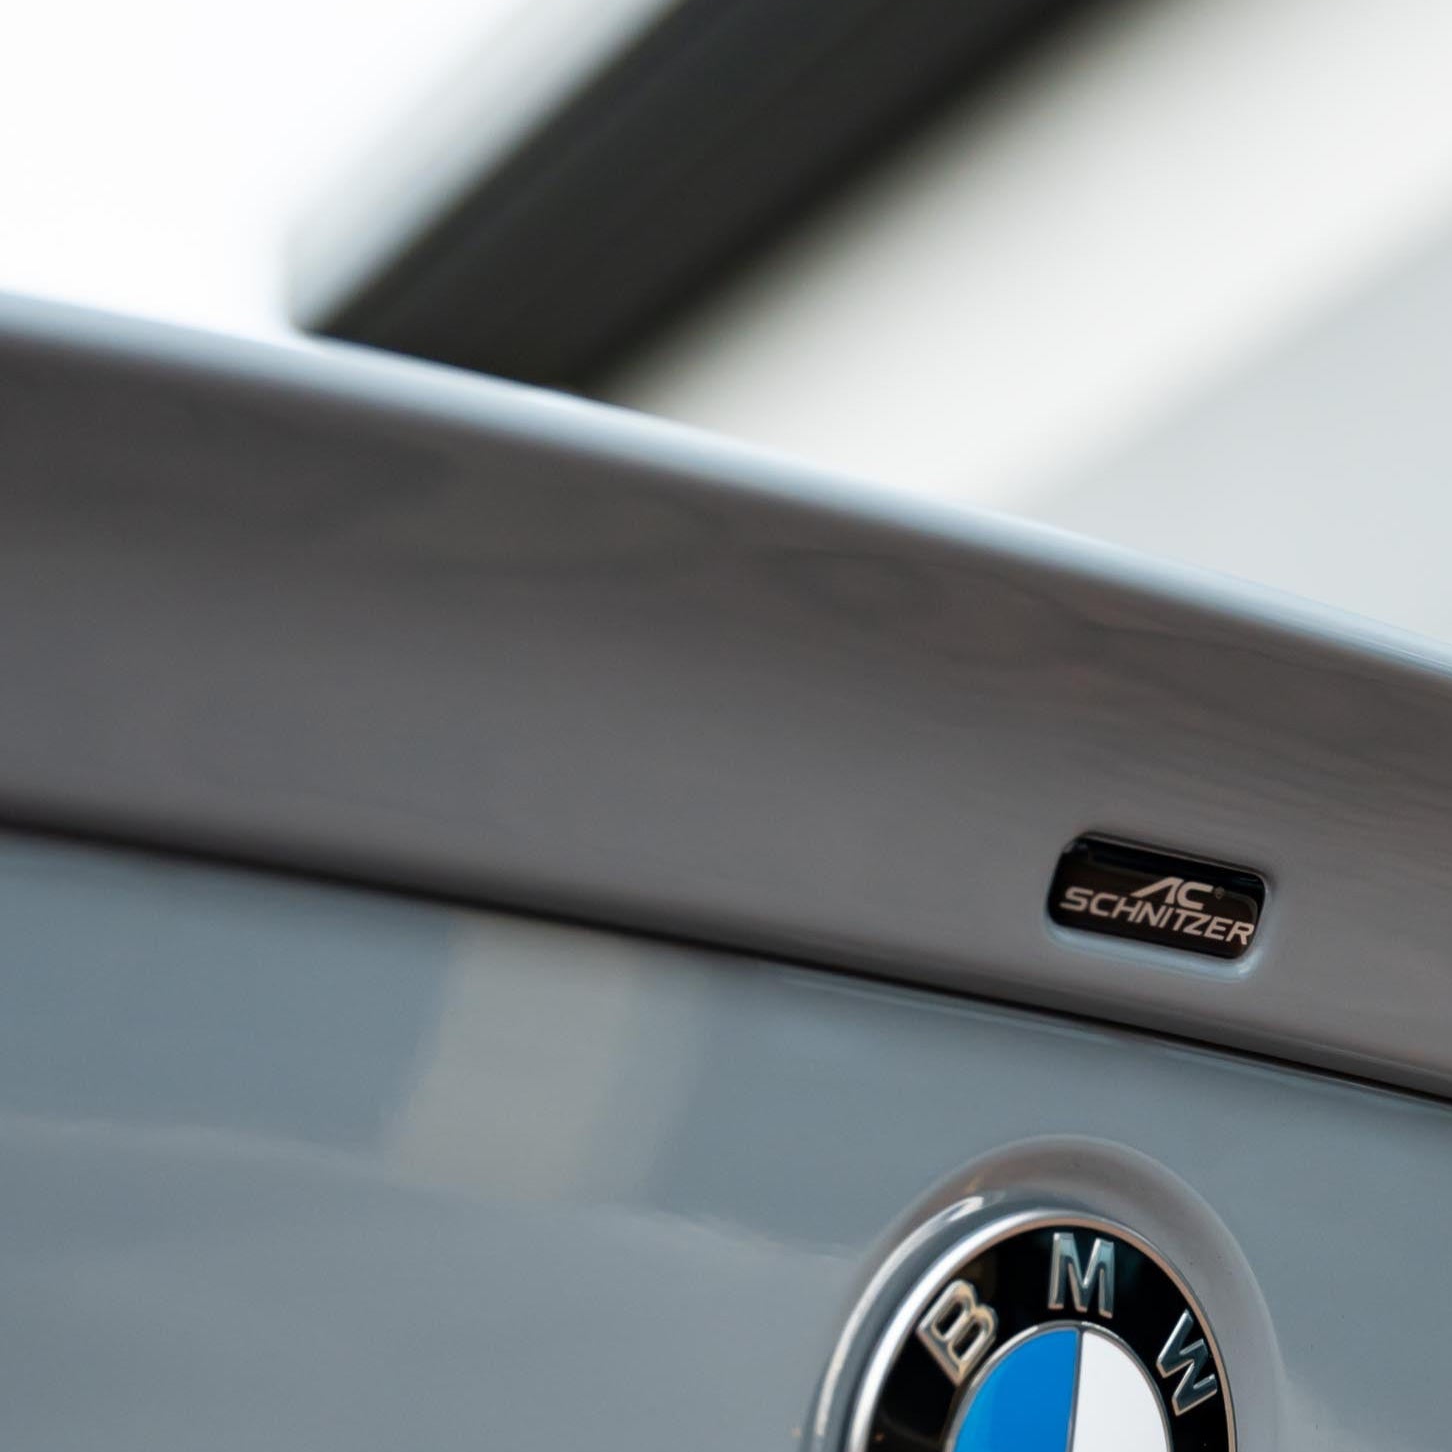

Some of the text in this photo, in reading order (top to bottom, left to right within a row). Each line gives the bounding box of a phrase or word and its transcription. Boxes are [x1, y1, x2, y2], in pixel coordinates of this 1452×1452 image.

[1059, 886, 1255, 945] SCHNITZER
[1130, 876, 1214, 910] AC
[917, 1231, 1218, 1417] BMW
